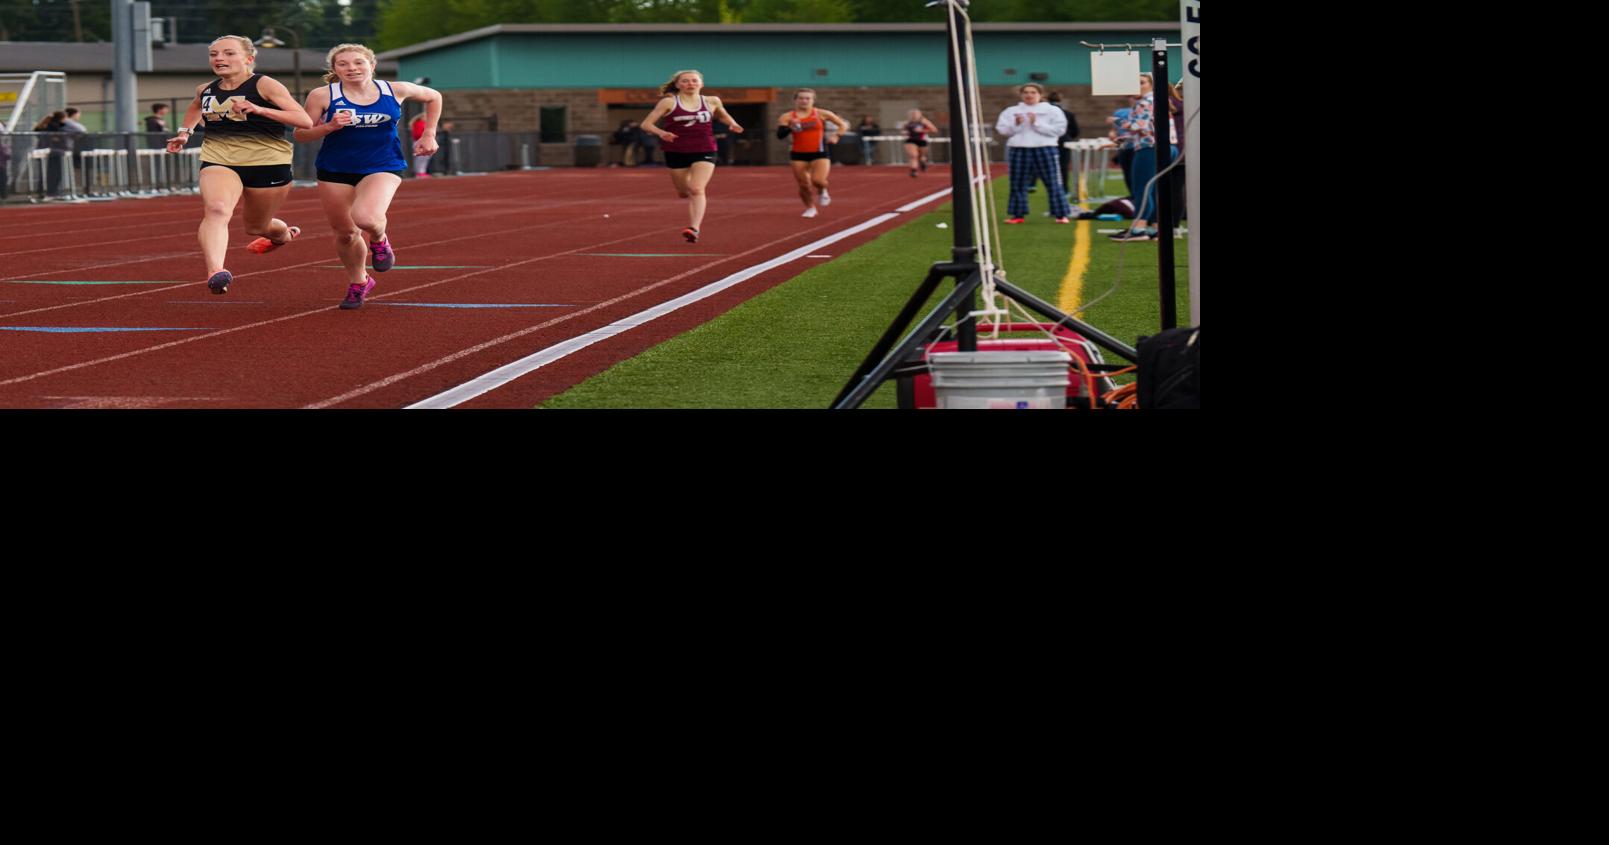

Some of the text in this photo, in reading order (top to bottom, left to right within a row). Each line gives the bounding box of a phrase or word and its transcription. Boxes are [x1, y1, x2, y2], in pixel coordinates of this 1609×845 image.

[202, 97, 211, 111] 4
[203, 95, 247, 121] M
[355, 114, 385, 124] SW
